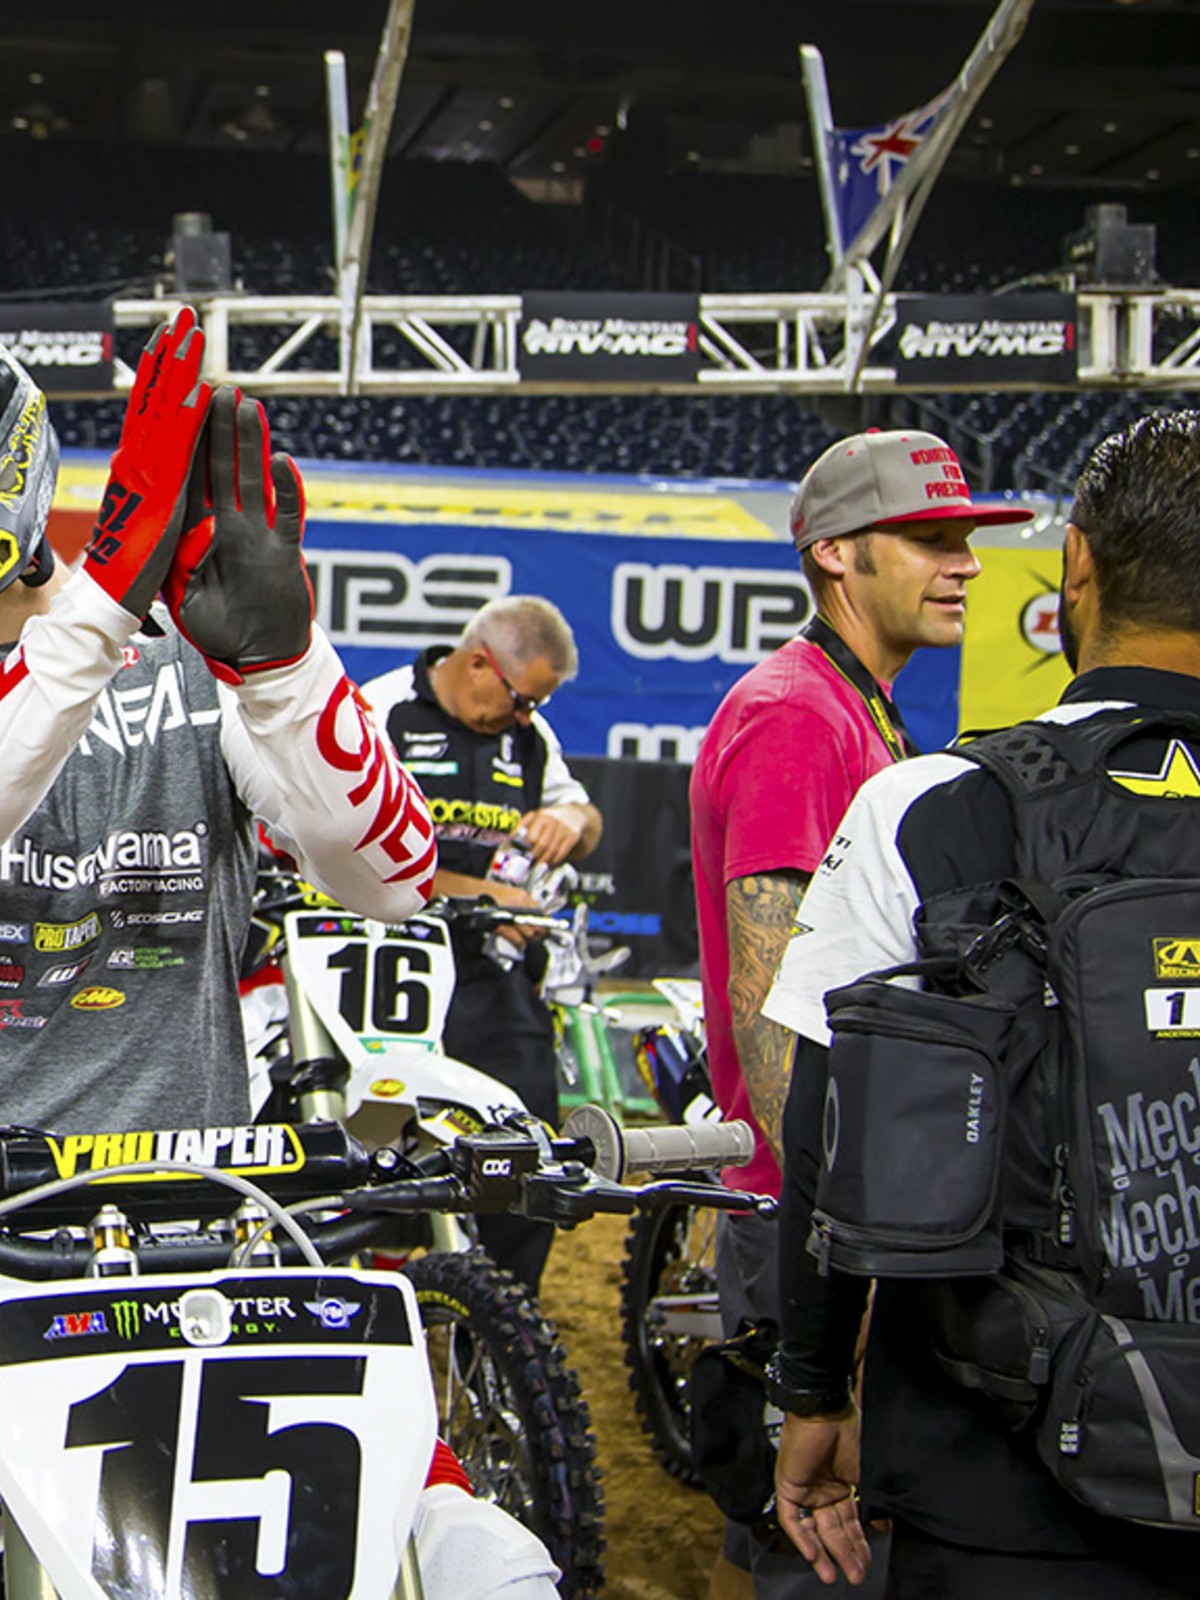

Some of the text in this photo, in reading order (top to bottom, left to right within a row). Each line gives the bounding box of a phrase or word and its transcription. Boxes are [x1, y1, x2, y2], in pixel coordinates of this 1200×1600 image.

[620, 570, 812, 655] WP
[327, 942, 432, 1034] 16
[965, 1072, 984, 1143] OAKLEY
[43, 1312, 107, 1341] AMA
[64, 1355, 368, 1600] 15
